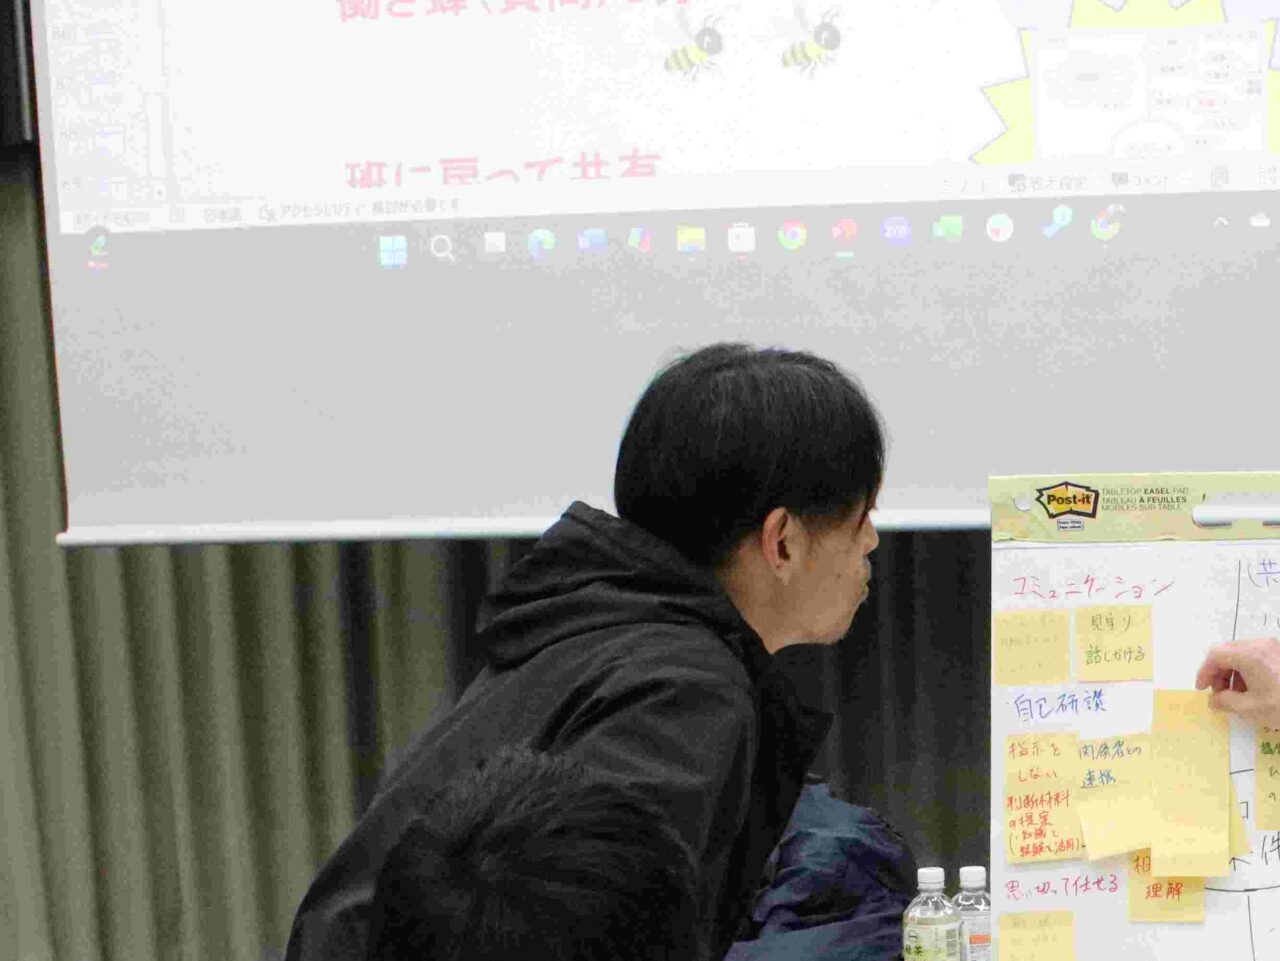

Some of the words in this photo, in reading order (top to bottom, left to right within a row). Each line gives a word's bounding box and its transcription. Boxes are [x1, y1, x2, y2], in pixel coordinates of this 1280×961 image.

[1101, 487, 1142, 495] TABLETOP
[1047, 493, 1092, 506] Post-it
[1158, 503, 1182, 511] TABLE
[1144, 881, 1184, 902] 理解
